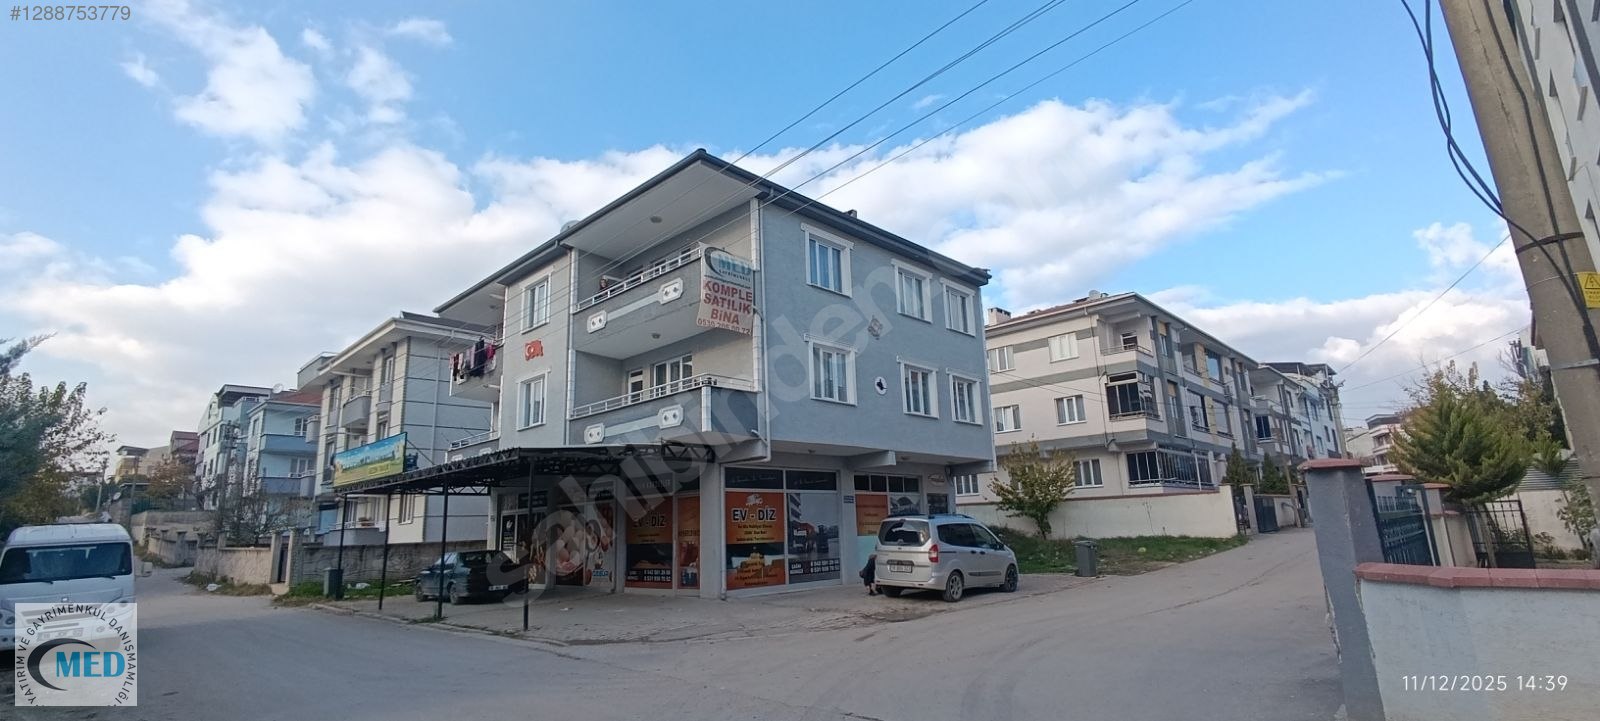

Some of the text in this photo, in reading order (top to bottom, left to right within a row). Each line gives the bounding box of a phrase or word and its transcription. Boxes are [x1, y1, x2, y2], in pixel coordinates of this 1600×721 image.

[704, 280, 752, 302] KOMPLE
[703, 293, 752, 315] SATILIK
[732, 507, 748, 522] EV
[757, 505, 777, 522] DİZ
